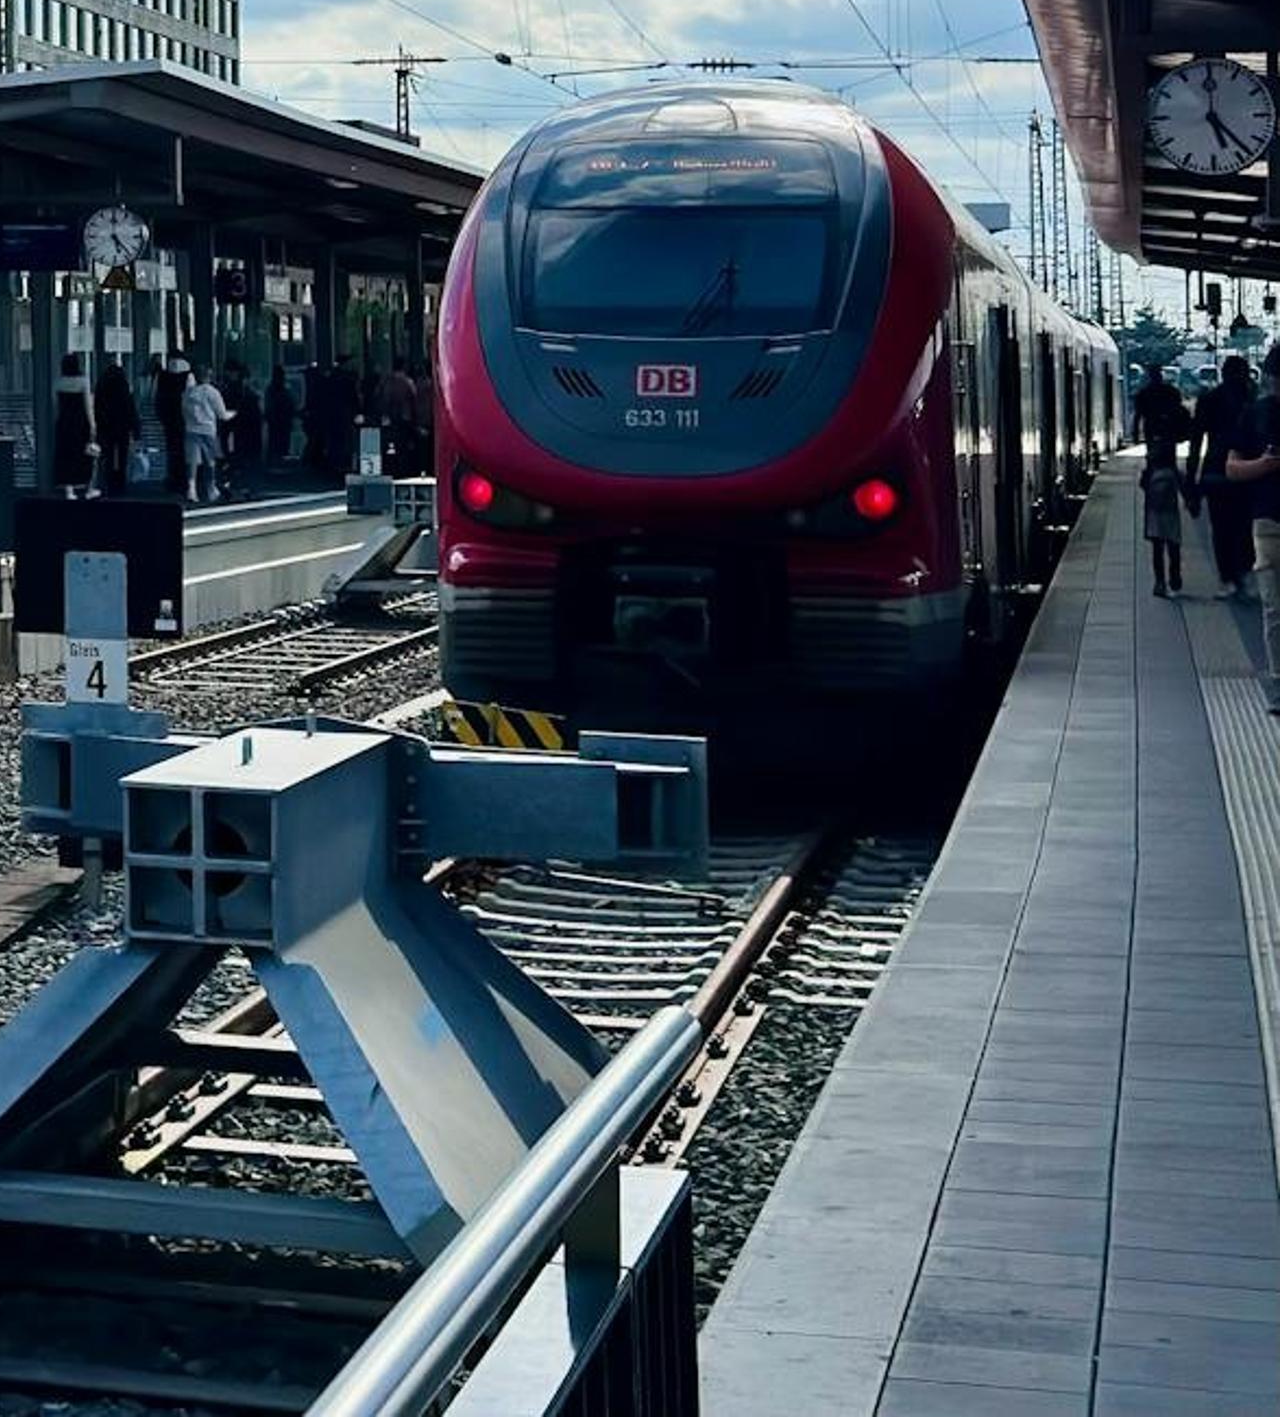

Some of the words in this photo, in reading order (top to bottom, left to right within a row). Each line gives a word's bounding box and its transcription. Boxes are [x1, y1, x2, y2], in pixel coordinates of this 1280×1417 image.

[640, 367, 692, 394] DB
[625, 409, 666, 426] 633
[675, 409, 699, 427] 111
[70, 642, 100, 657] Gleis
[86, 660, 107, 698] 4
